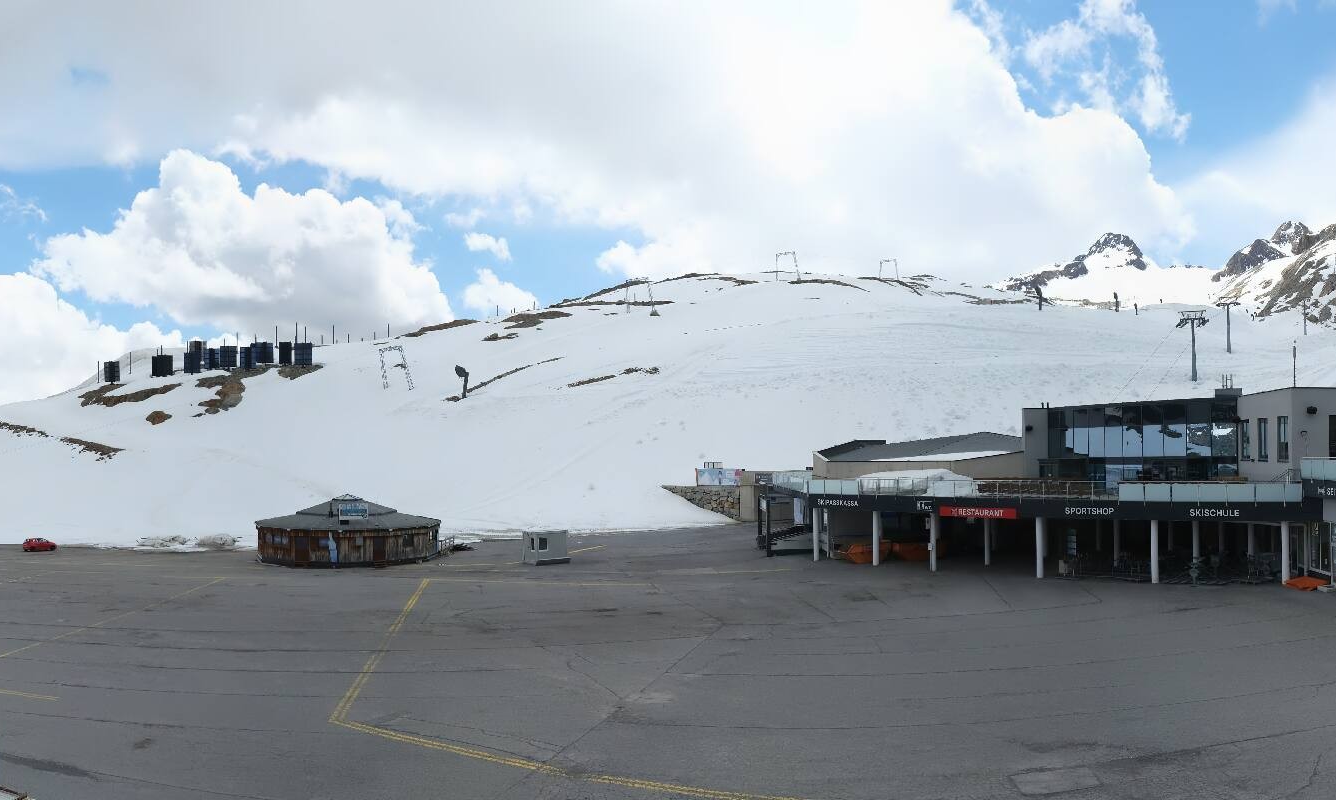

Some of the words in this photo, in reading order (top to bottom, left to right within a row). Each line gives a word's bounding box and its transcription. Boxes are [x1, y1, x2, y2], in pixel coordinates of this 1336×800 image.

[958, 508, 1004, 517] RESTAURANT
[1064, 507, 1114, 515] SPORTSHOP
[1189, 508, 1240, 517] SKISCHULE
